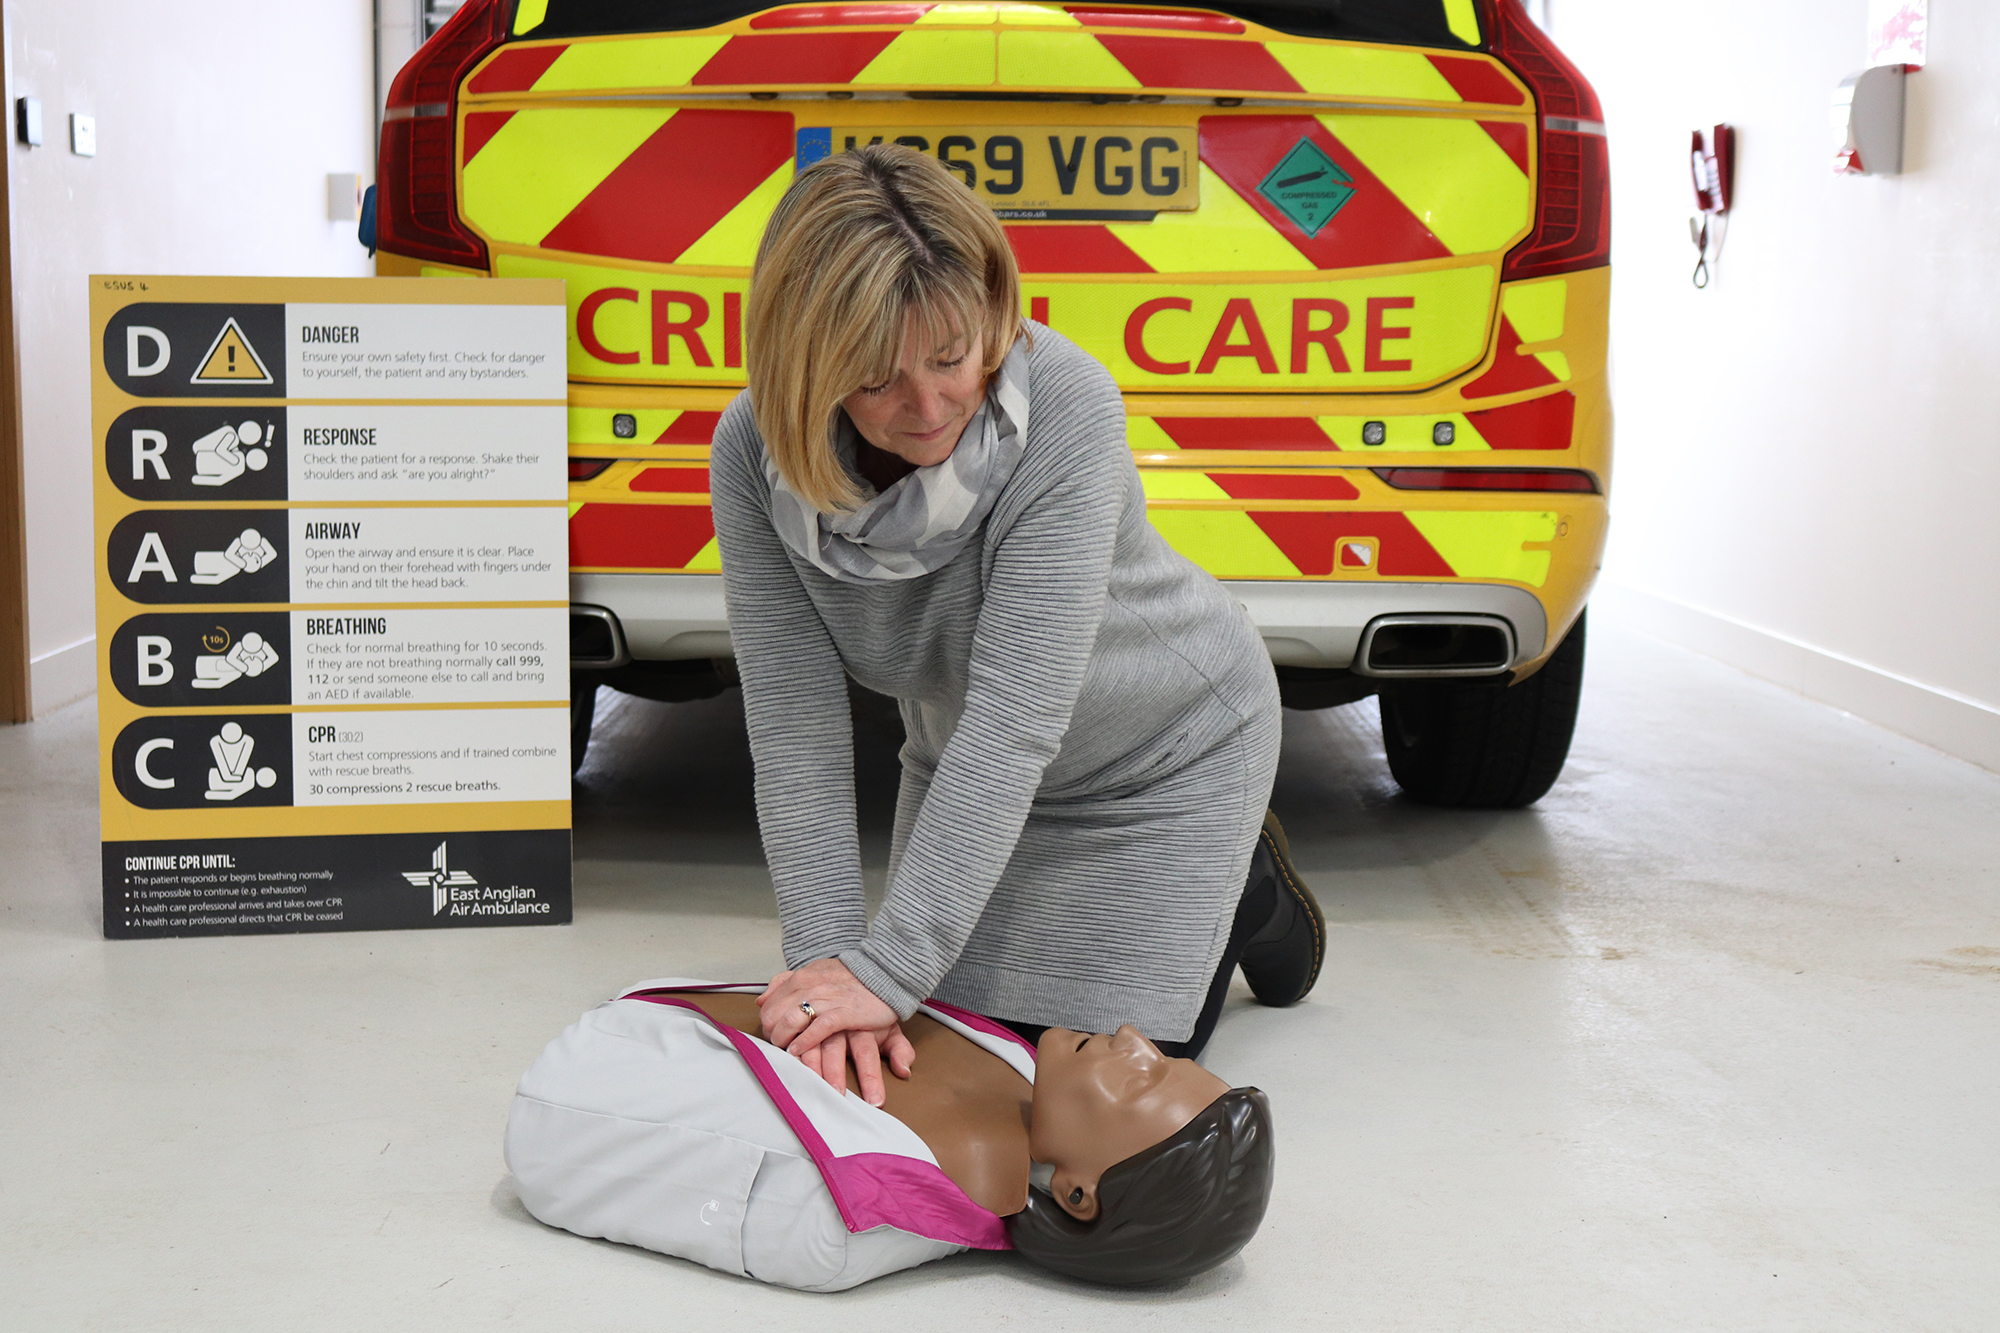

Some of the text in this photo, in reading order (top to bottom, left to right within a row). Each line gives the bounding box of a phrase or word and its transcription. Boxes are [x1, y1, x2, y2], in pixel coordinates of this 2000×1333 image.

[1048, 136, 1181, 196] VGG
[1308, 212, 1314, 220] 2
[302, 326, 359, 343] DANGER
[1124, 296, 1414, 375] CARE
[126, 326, 172, 376] D
[302, 351, 338, 362] Ensure
[340, 354, 364, 364] your
[394, 351, 426, 365] safety
[429, 351, 450, 362] first.
[454, 352, 487, 362] Check
[491, 352, 506, 362] for
[508, 352, 545, 365] danger
[302, 366, 528, 380] to yourself, the patient and any bystanders.
[304, 428, 377, 445] RESPONSE
[132, 429, 171, 480] R
[303, 453, 337, 463] Check
[340, 453, 358, 464] the
[361, 455, 398, 466] patient
[401, 453, 416, 464] for
[429, 456, 478, 466] response.
[481, 453, 513, 464] Shake
[516, 453, 539, 464] their
[304, 469, 355, 480] shoulders
[357, 469, 378, 480] and
[381, 469, 398, 479] ask
[428, 472, 448, 482] you
[305, 522, 361, 539] AIRWAY
[128, 532, 178, 583] A
[305, 548, 335, 560] Open
[338, 547, 356, 558] the
[358, 550, 393, 560] airway
[396, 547, 416, 557] and
[419, 549, 454, 557] ensure
[457, 548, 464, 557] it
[477, 546, 504, 557] clear.
[508, 546, 534, 556] Place
[305, 566, 329, 576] your
[332, 563, 360, 573] hand
[380, 562, 403, 573] their
[407, 562, 454, 572] forehead
[456, 562, 480, 572] with
[483, 561, 519, 574] fingers
[521, 561, 552, 572] under
[306, 577, 468, 588] the chin and tilt the head back.
[306, 617, 386, 635] BREATHING
[210, 636, 224, 644] 10s
[306, 640, 547, 655] Check for normal breathing for 10 seconds.
[136, 636, 174, 686] B
[307, 658, 314, 668] If
[318, 659, 342, 671] they
[366, 659, 385, 668] not
[389, 657, 442, 670] breathing
[446, 656, 493, 669] normally
[496, 656, 516, 666] call
[519, 655, 544, 667] 999,
[308, 674, 329, 684] 112
[348, 673, 374, 684] send
[377, 675, 428, 683] someone
[431, 672, 453, 682] else
[456, 673, 468, 682] to
[470, 671, 489, 682] call
[492, 671, 513, 681] and
[516, 670, 544, 684] bring
[325, 689, 349, 699] AED
[352, 688, 360, 698] if
[363, 688, 414, 699] available.
[308, 726, 336, 743] CPR
[308, 746, 557, 762] Start chest compressions and if trained combine
[134, 738, 176, 789] C
[308, 764, 414, 776] with rescue breaths.
[310, 780, 501, 796] 30 compressions 2 rescue breaths.
[125, 854, 236, 871] CONTINUE CPR UNTIL:
[133, 876, 149, 885] The
[150, 876, 179, 886] patient
[181, 874, 218, 885] responds
[230, 872, 257, 884] begins
[258, 871, 297, 883] breathing
[298, 870, 334, 881] normally
[133, 890, 139, 899] It
[149, 888, 192, 900] impossible
[193, 889, 202, 897] to
[203, 888, 240, 897] continue
[240, 887, 259, 897] (e.g.
[260, 885, 307, 895] exhaustion)
[450, 886, 536, 902] East Anglian
[133, 904, 141, 913] A
[142, 903, 168, 913] health
[188, 901, 237, 913] professional
[238, 902, 265, 910] arrives
[266, 900, 282, 909] and
[283, 899, 305, 908] takes
[325, 897, 343, 907] CPR
[450, 900, 550, 915] Air Ambulance
[133, 918, 141, 927] A
[142, 917, 168, 927] health
[189, 915, 237, 926] professional
[238, 914, 266, 924] directs
[267, 913, 284, 922] that
[285, 912, 302, 922] CPR
[303, 912, 314, 921] be
[315, 911, 344, 921] ceased
